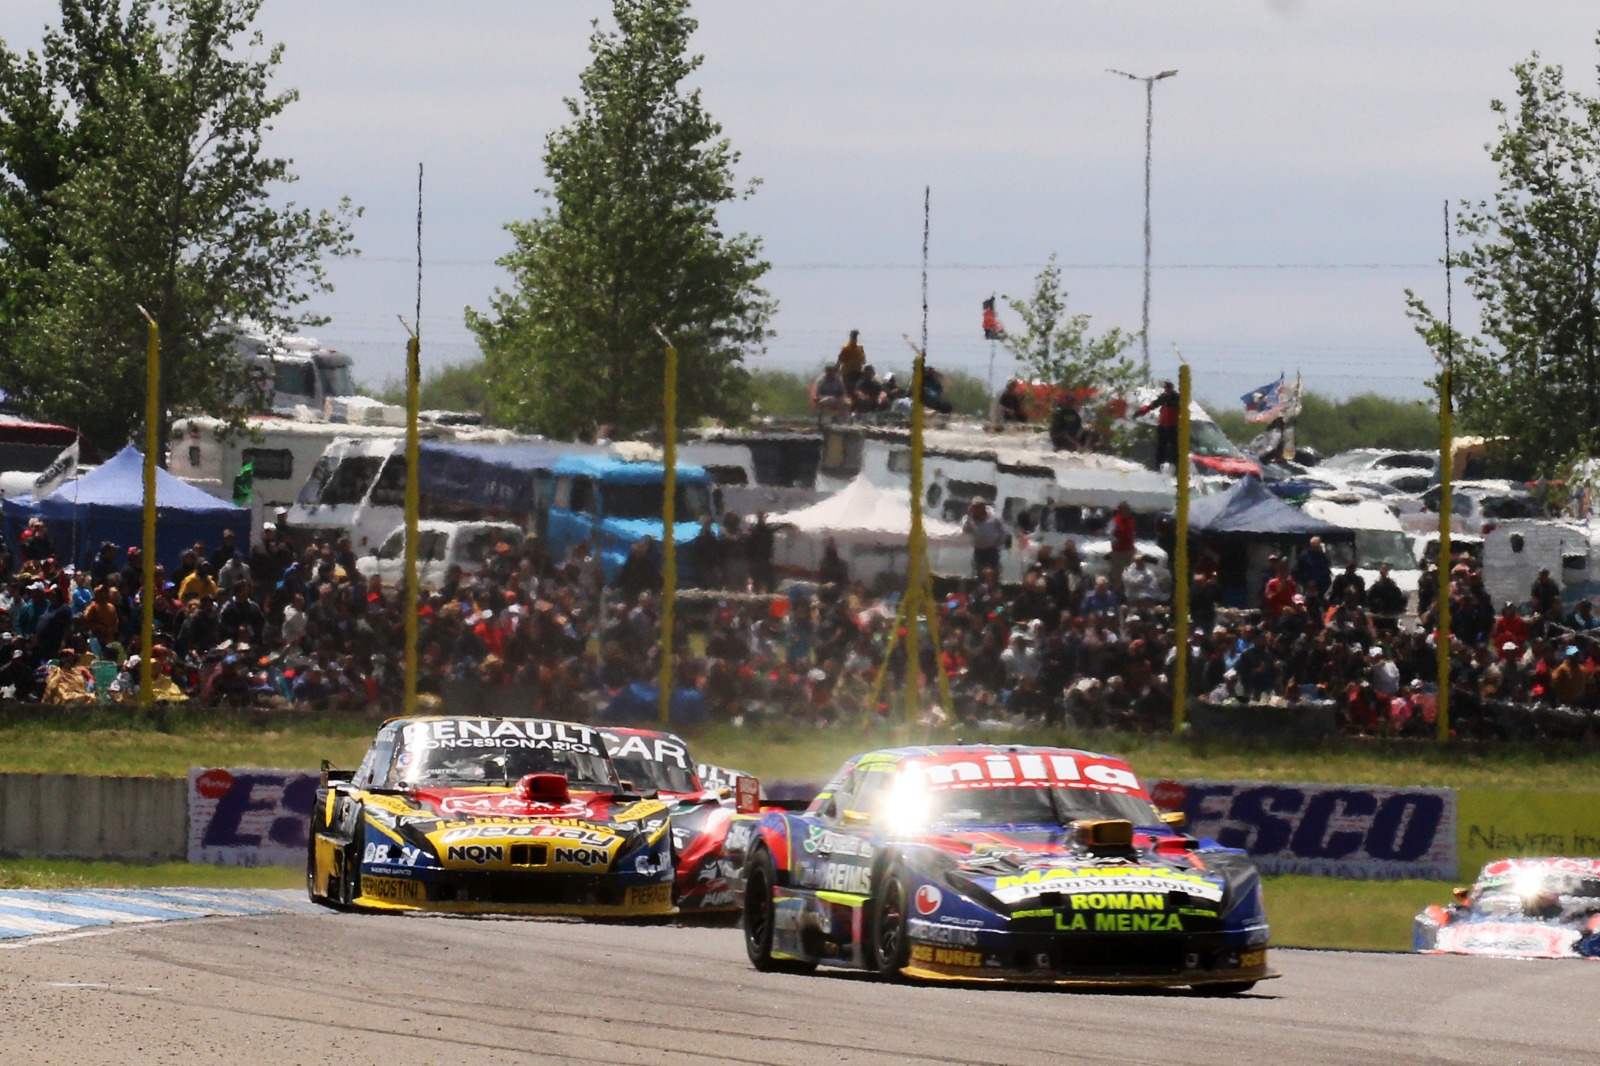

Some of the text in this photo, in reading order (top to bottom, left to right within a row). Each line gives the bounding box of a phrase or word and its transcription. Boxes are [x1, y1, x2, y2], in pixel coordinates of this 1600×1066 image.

[402, 720, 597, 746] RENAULT
[918, 754, 1140, 790] milla
[448, 846, 608, 866] NQN NQN
[1070, 893, 1165, 910] ROMAN
[1054, 912, 1087, 931] LA
[1095, 913, 1184, 931] MENZA
